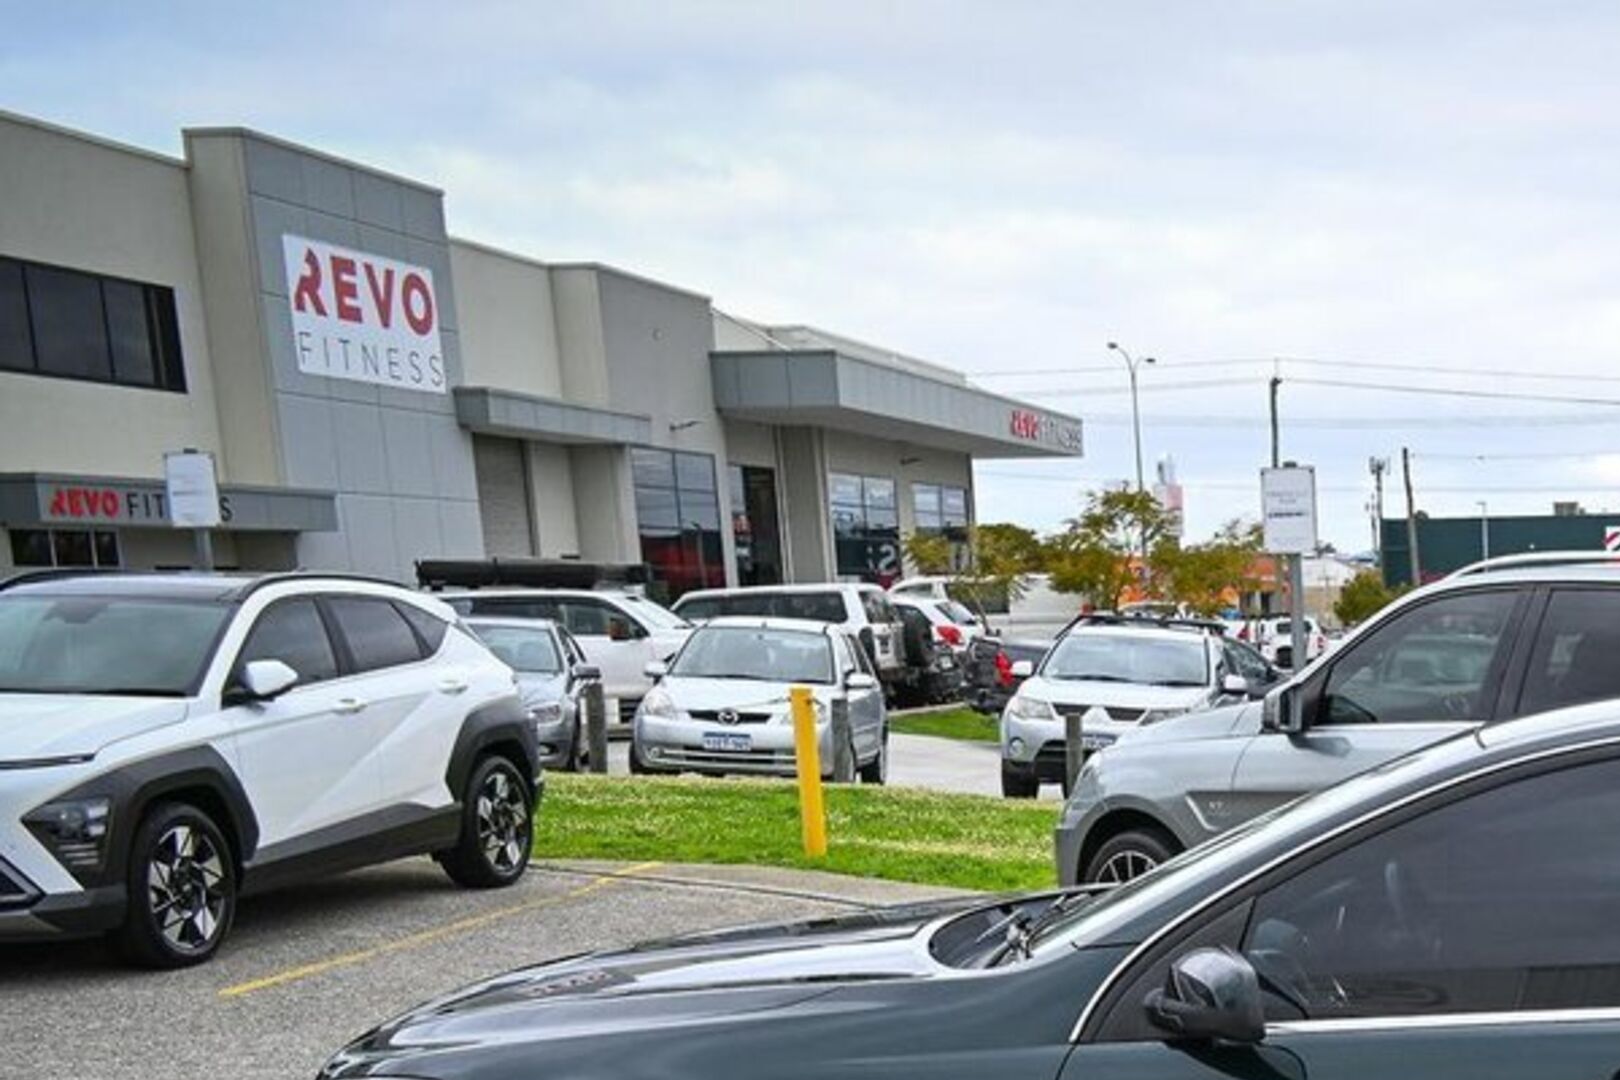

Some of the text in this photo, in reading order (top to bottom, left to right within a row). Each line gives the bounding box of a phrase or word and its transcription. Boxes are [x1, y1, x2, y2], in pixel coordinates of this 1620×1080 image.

[294, 247, 433, 336] REVO
[299, 331, 443, 387] FITNESS
[50, 487, 120, 518] REVO
[126, 493, 232, 522] FITS
